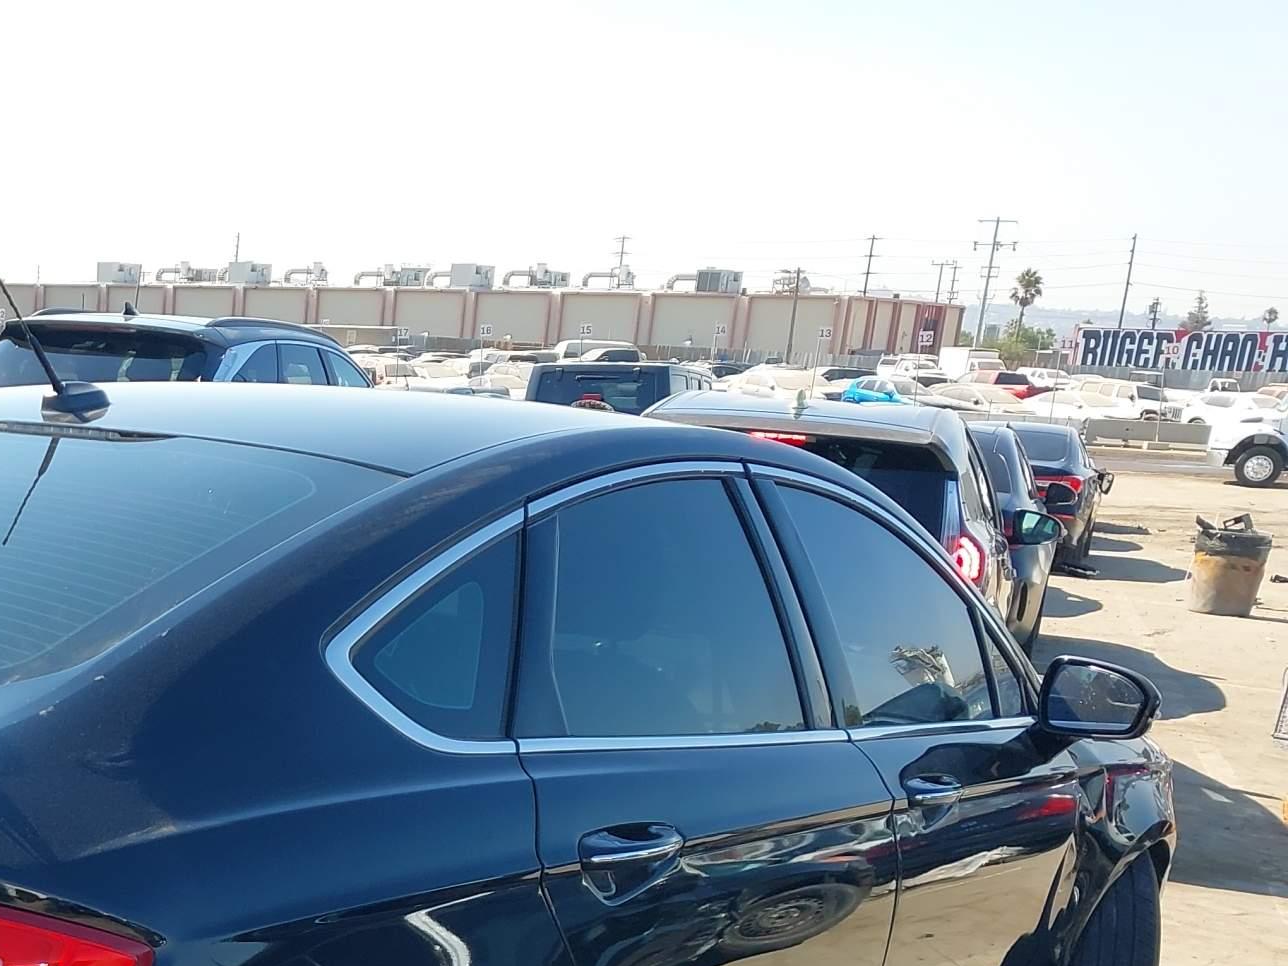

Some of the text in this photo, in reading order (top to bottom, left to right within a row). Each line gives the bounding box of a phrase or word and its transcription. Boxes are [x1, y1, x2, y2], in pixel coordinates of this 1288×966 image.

[397, 328, 409, 337] 17
[580, 326, 592, 335] 15
[715, 326, 726, 335] 14
[819, 328, 832, 338] 13
[919, 333, 932, 343] 12
[1165, 345, 1179, 355] 10
